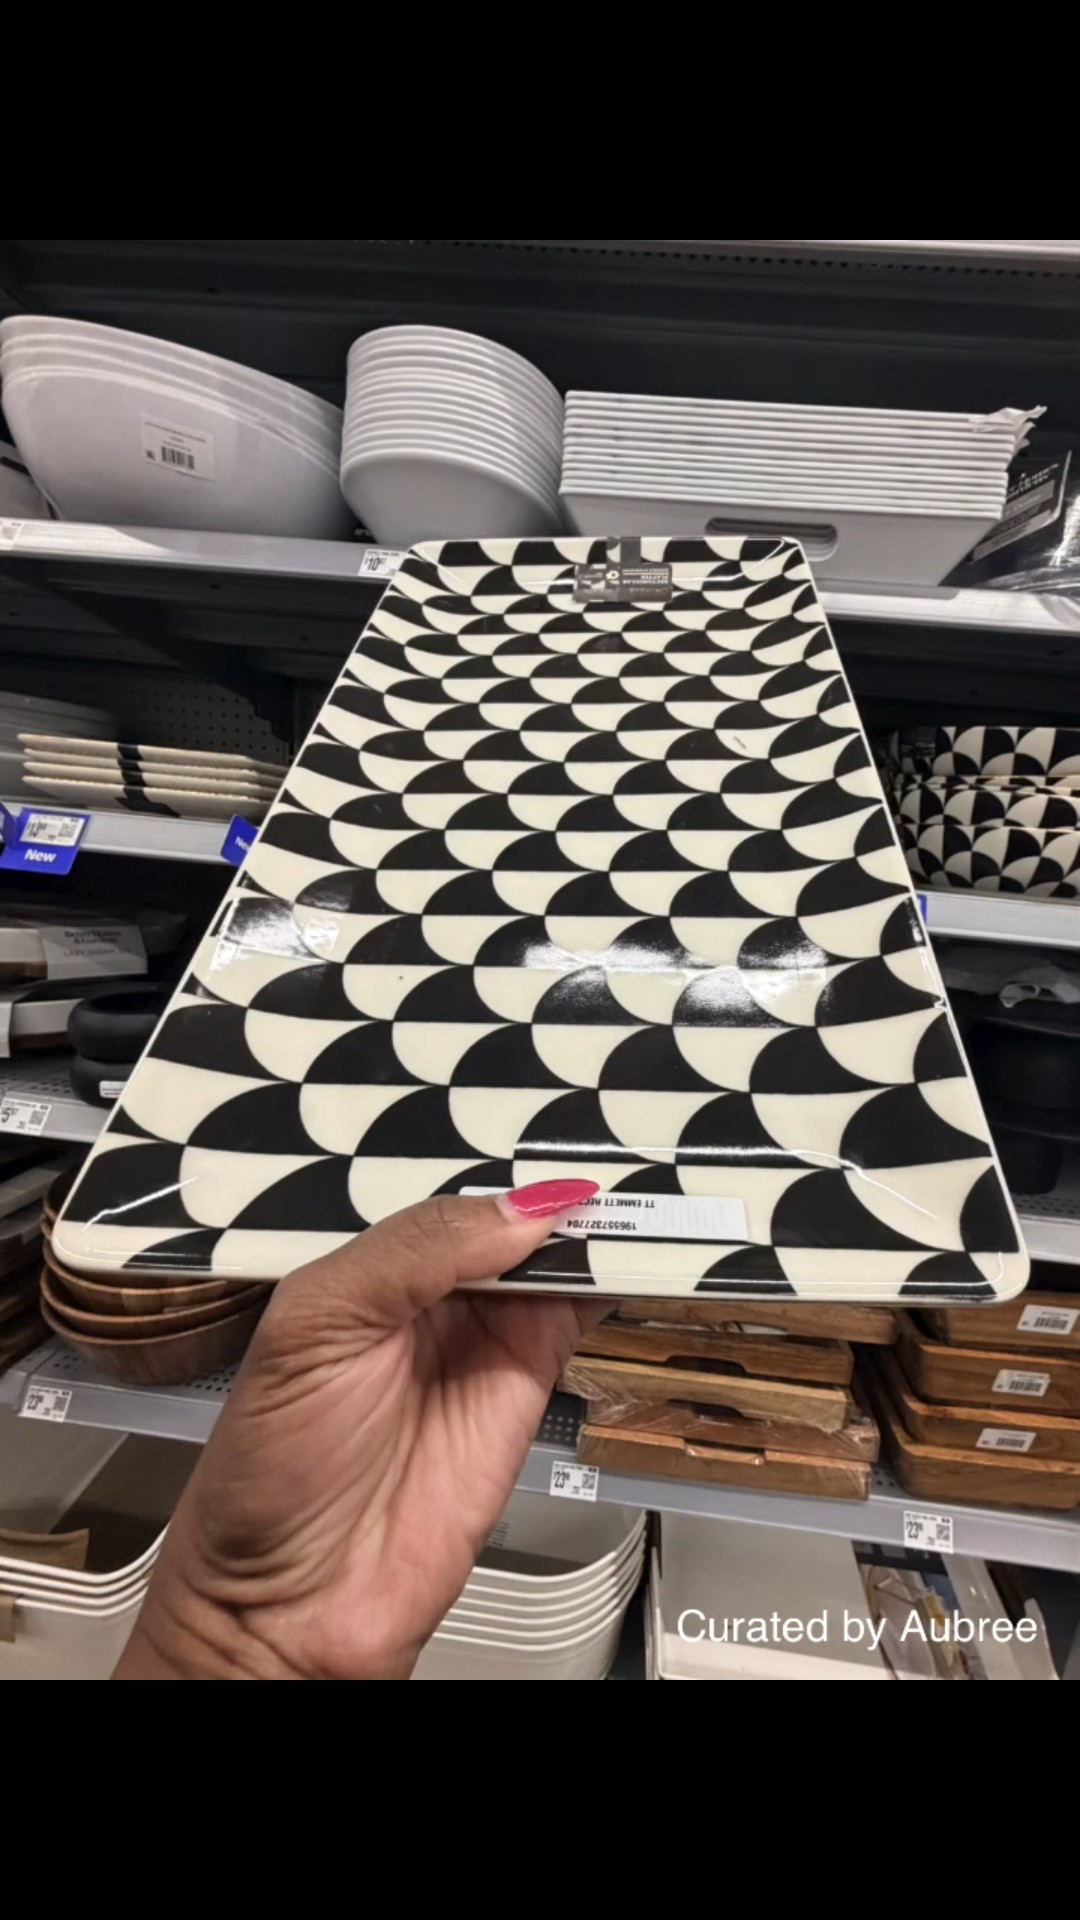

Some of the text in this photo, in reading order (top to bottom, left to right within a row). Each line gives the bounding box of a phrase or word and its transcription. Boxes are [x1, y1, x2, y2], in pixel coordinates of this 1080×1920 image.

[24, 848, 57, 863] New
[604, 1198, 642, 1208] EMMETT
[644, 1199, 655, 1208] TT
[567, 1219, 637, 1231] 196557327704
